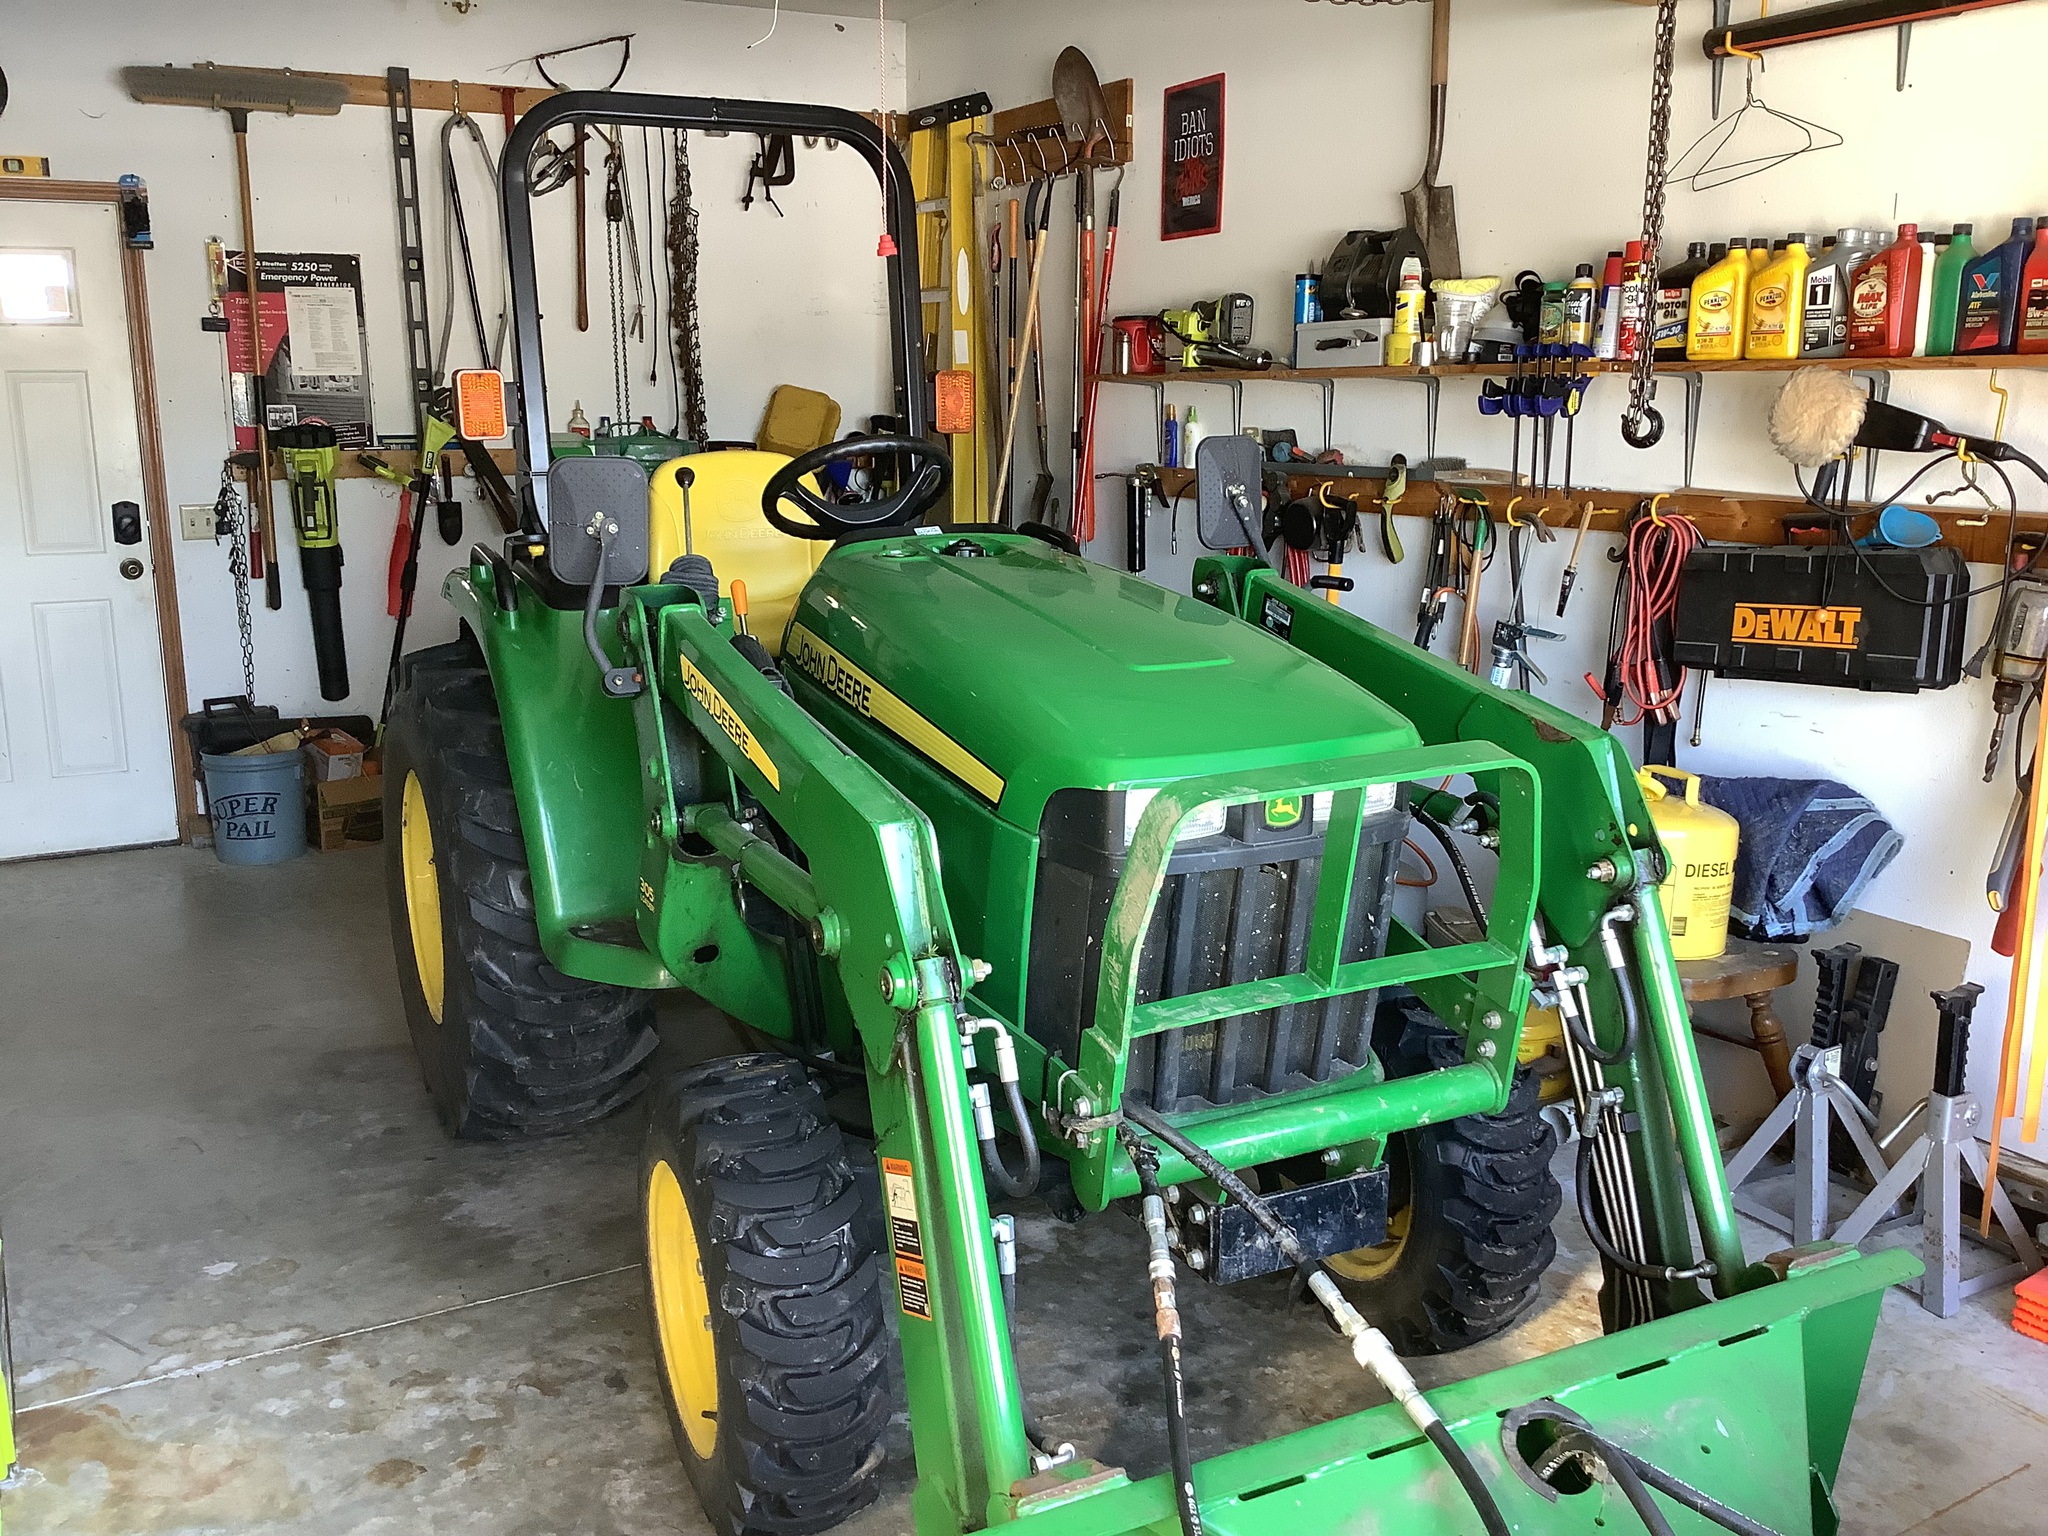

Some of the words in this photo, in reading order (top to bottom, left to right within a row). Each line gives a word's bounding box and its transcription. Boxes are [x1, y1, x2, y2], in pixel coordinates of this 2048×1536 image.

[1181, 108, 1207, 136] BAN
[1174, 133, 1214, 162] IDIOTS
[291, 262, 318, 272] 5250
[261, 272, 308, 283] Emergency
[310, 274, 339, 282] Power
[1810, 275, 1833, 284] Mobil
[1621, 284, 1649, 294] Scoth
[1971, 290, 1998, 299] Valvoline
[1704, 296, 1728, 306] PENNZOIL
[1760, 292, 1782, 302] PENNZOIL
[1857, 291, 1884, 304] MAX
[1656, 301, 1688, 310] MOTOR
[1968, 301, 1982, 309] ATF
[1663, 310, 1678, 319] OIL
[1655, 325, 1682, 340] 5W-30
[705, 528, 738, 541] JOHN
[1732, 606, 1862, 645] DEWALT
[796, 634, 826, 680] JOHN
[827, 654, 872, 714] DEERE
[684, 665, 712, 711] JOHN
[713, 693, 749, 755] DEERE
[226, 820, 276, 837] PAIL
[1685, 862, 1729, 878] DIESEL
[640, 876, 654, 902] 305
[890, 1163, 908, 1173] WARNING
[904, 1266, 923, 1276] WARNING
